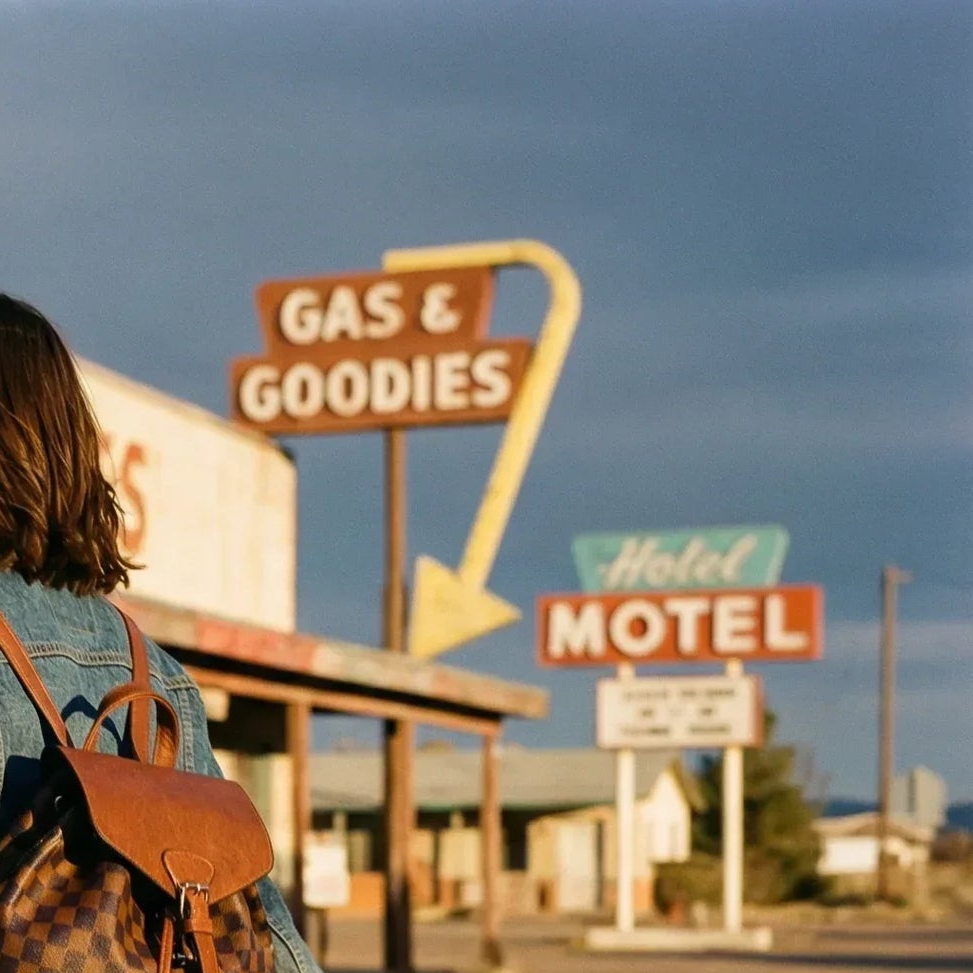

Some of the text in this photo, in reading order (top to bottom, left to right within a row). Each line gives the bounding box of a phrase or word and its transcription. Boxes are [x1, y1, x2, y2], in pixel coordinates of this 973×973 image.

[279, 281, 464, 346] GAS &
[238, 350, 514, 423] GOODIES
[546, 593, 810, 659] MOTEL
